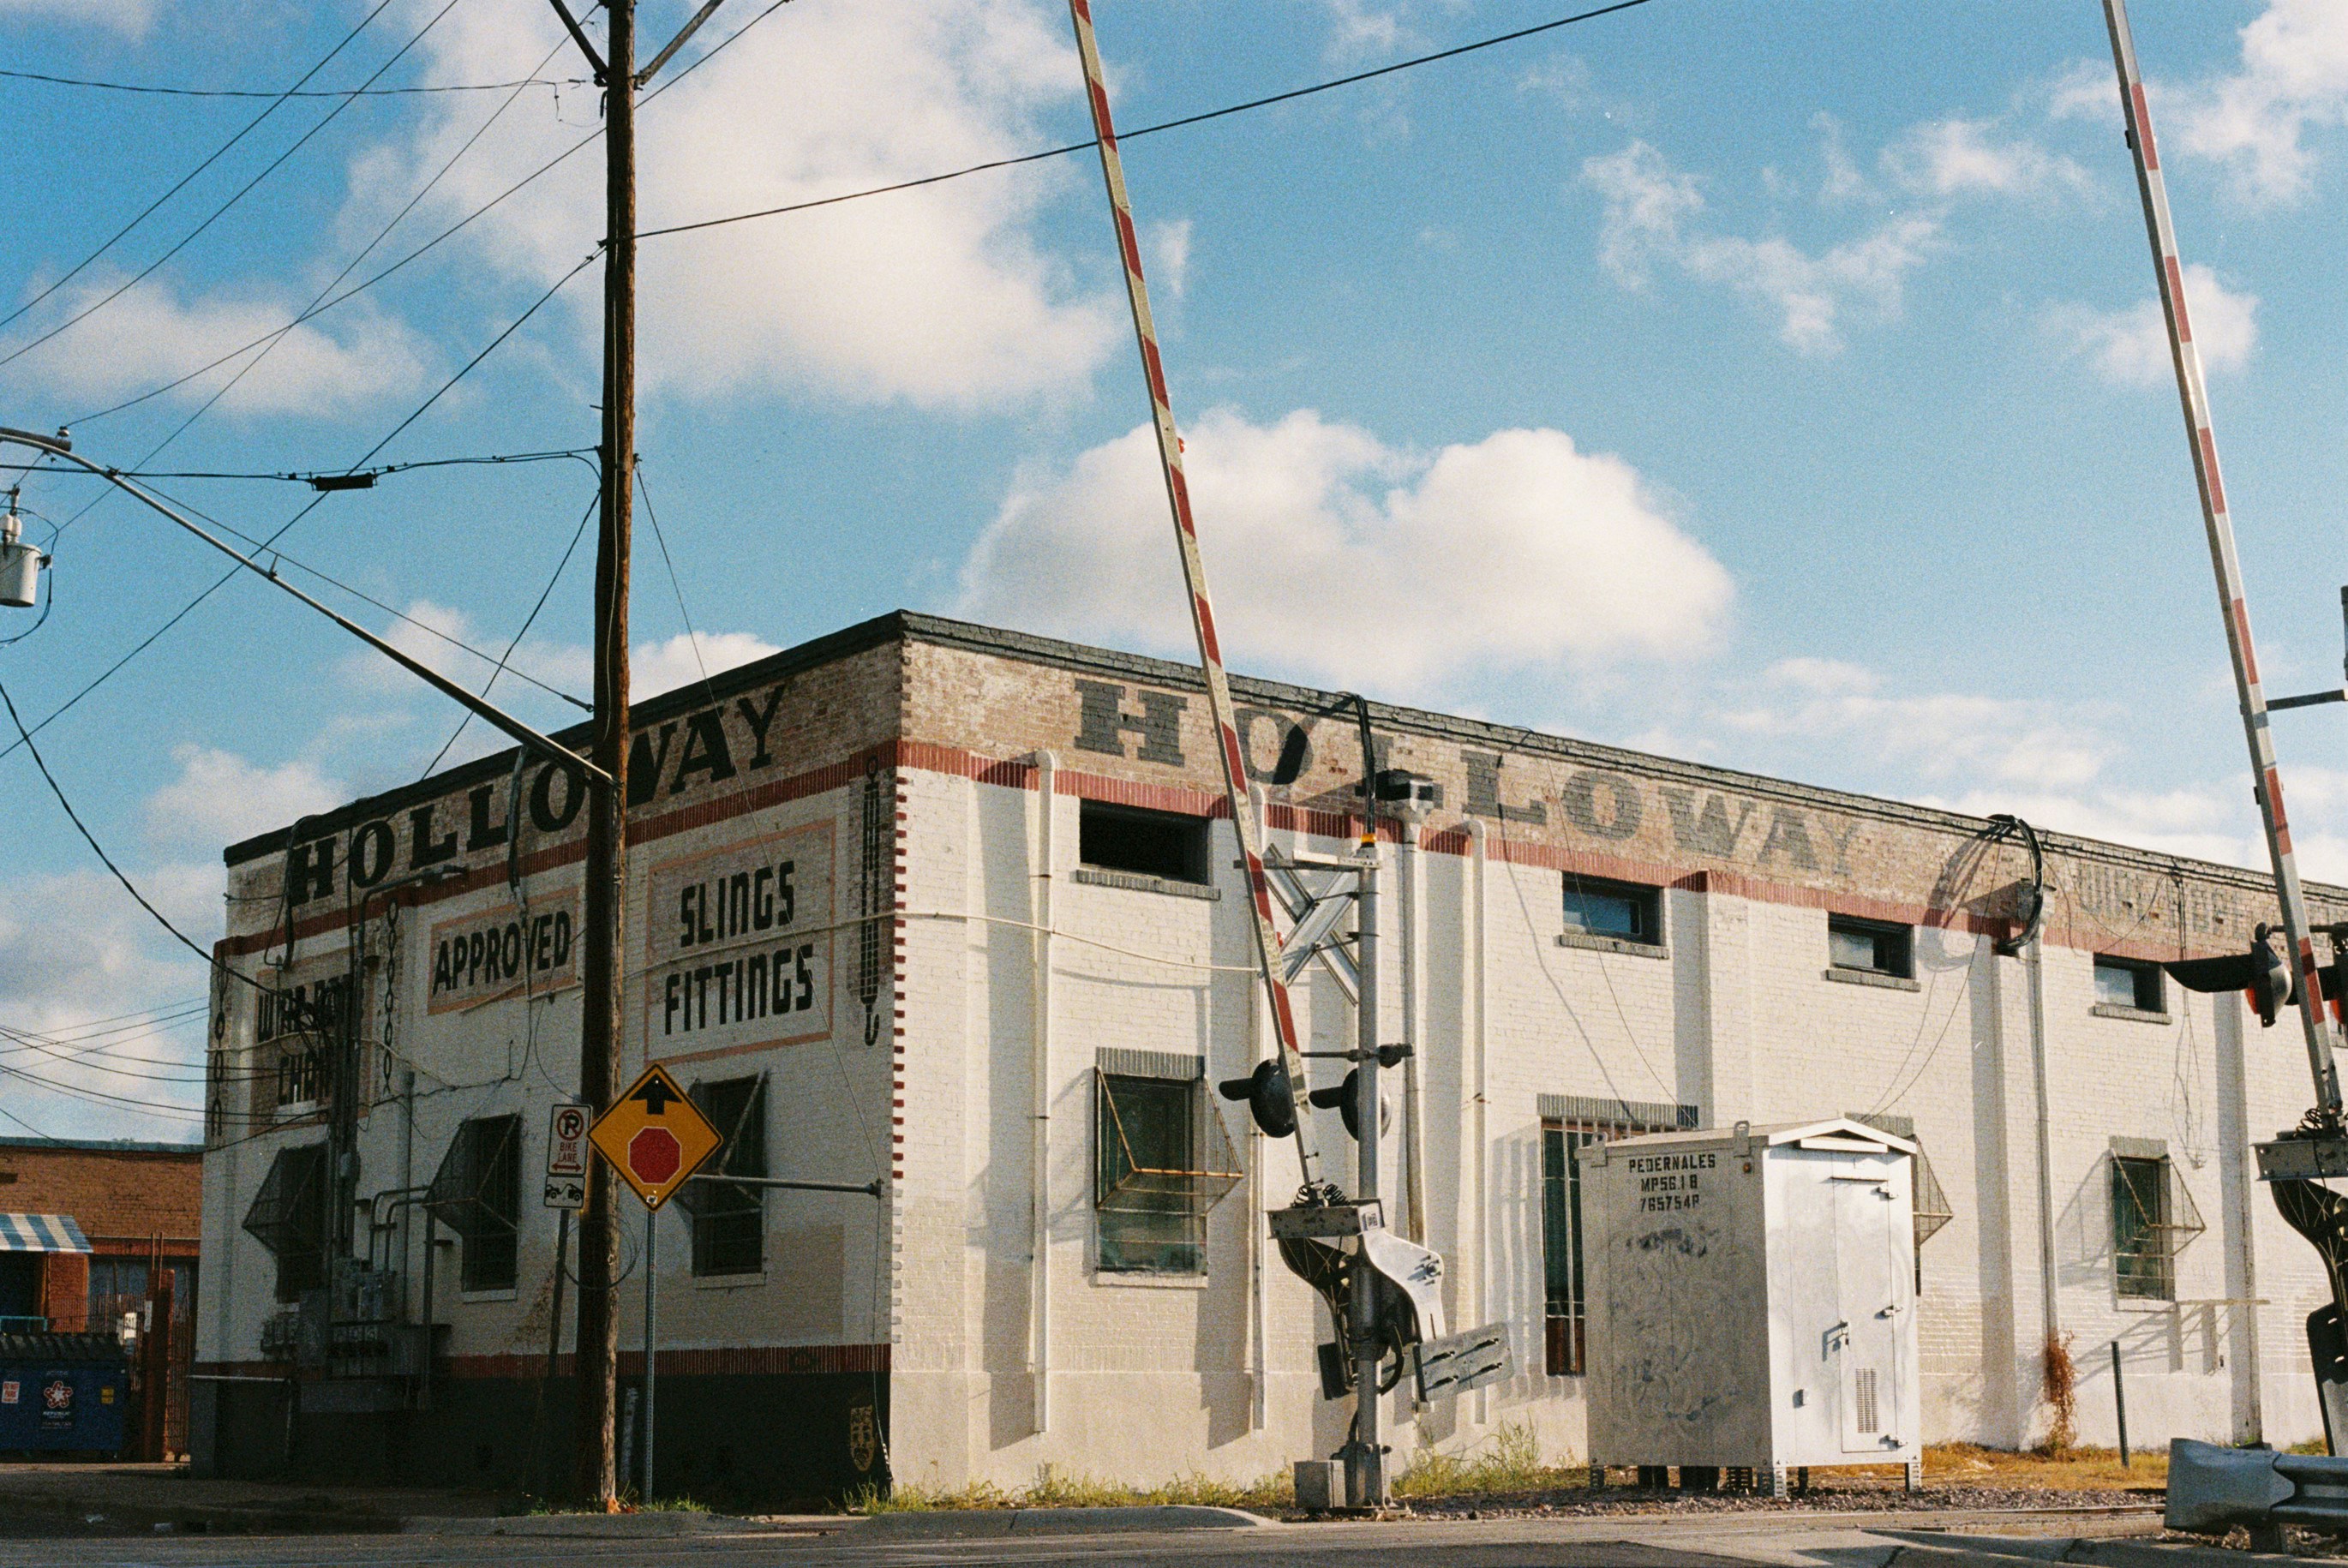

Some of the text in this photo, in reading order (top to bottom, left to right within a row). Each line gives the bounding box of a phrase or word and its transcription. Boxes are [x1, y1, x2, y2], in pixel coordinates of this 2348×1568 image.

[289, 683, 788, 907] HOLLOWAY
[1074, 679, 1863, 877] HOLLOWAY
[680, 860, 795, 948] SLINGS
[433, 910, 572, 996] APPROVED
[664, 944, 814, 1035] FITTINGS
[557, 1152, 578, 1163] LANE
[560, 1141, 577, 1152] BIKE
[1628, 1153, 1716, 1173] PEDERNALES
